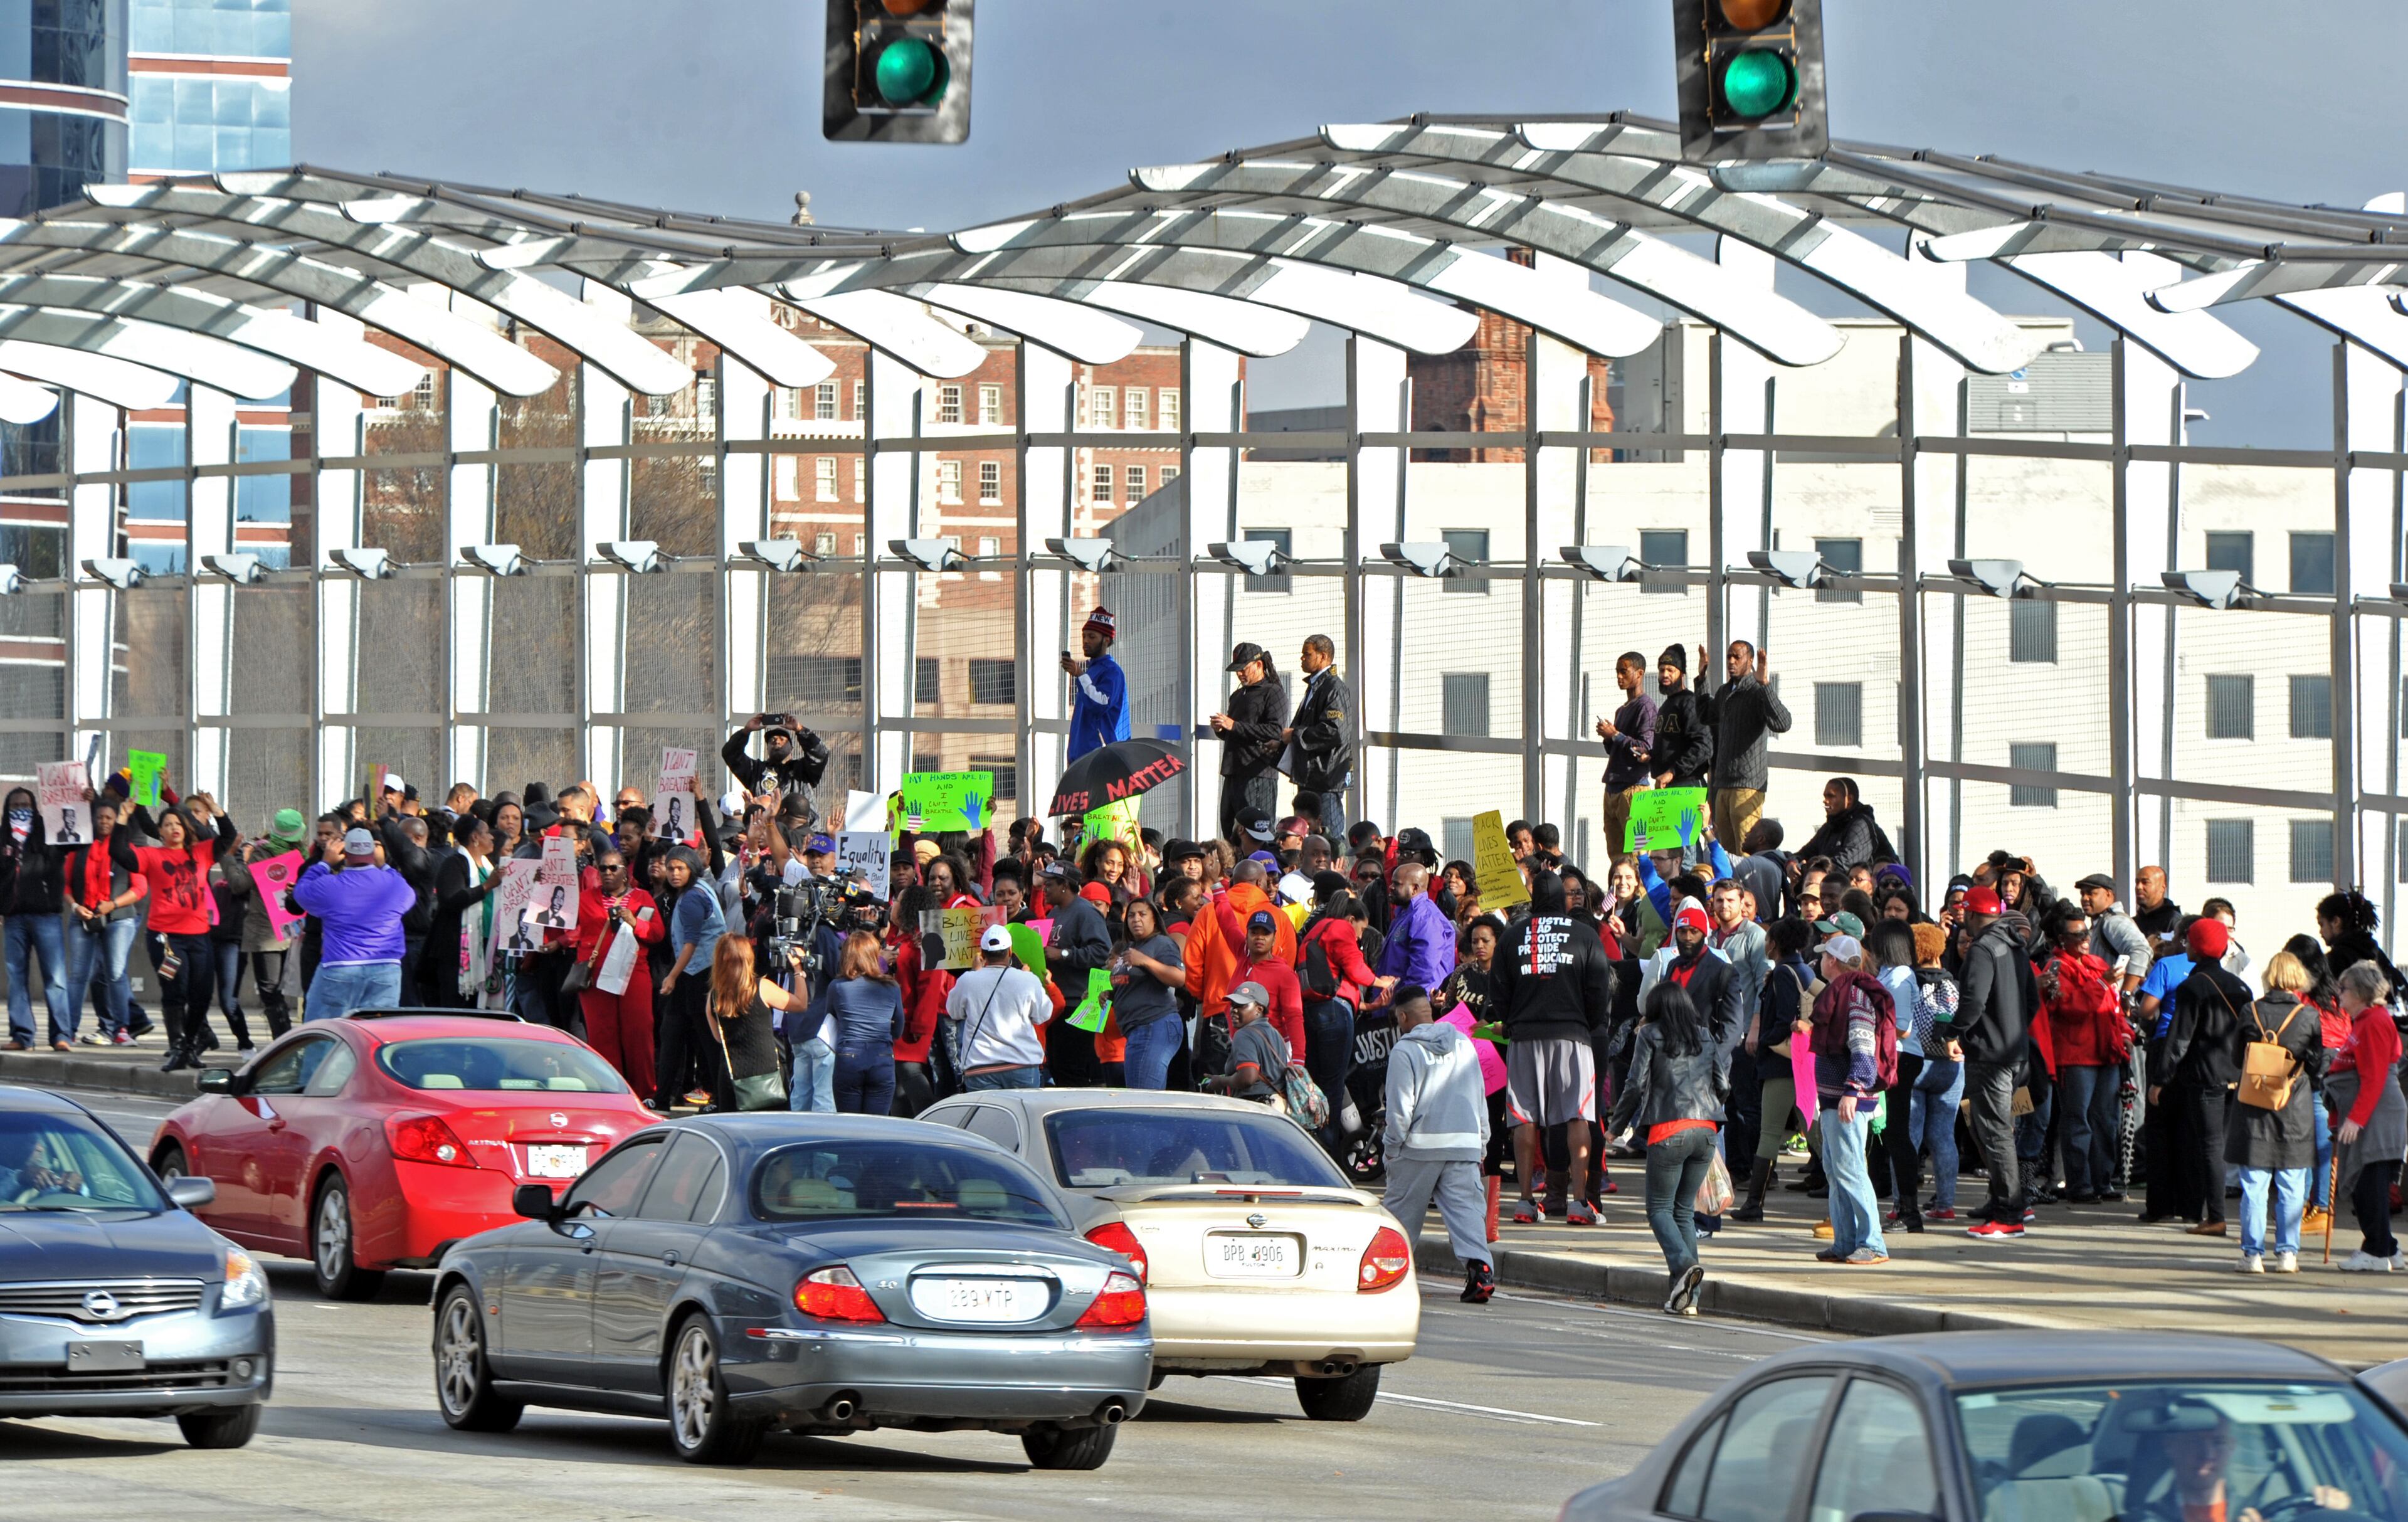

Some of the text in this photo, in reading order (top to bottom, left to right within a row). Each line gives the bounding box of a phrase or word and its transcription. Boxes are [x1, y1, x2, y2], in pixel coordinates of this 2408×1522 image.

[1094, 615, 1110, 623] NEW
[909, 774, 922, 784] MY
[930, 774, 957, 782] HANDS
[1106, 753, 1185, 801] MATTER
[658, 776, 694, 793] BREATH
[1050, 791, 1089, 814] LIVES
[1637, 792, 1646, 802] MY
[1651, 790, 1669, 798] HANDS
[1656, 806, 1663, 815] I
[548, 838, 561, 852] I
[1478, 835, 1499, 852] LIVES
[839, 837, 885, 871] Equality
[505, 860, 516, 877] I
[1475, 852, 1512, 872] MATTER
[942, 913, 989, 928] BLACK
[1531, 917, 1572, 926] HUSTLE
[949, 927, 985, 942] LIVES
[1526, 924, 1551, 934] LEAD
[1524, 933, 1570, 944] PROTECT
[1518, 943, 1559, 956] PROVIDE
[1531, 953, 1573, 964] EDUCATE
[1521, 963, 1557, 975] INSPIRE
[1223, 1245, 1283, 1262] BPB 8906
[985, 1289, 1013, 1308] YTP
